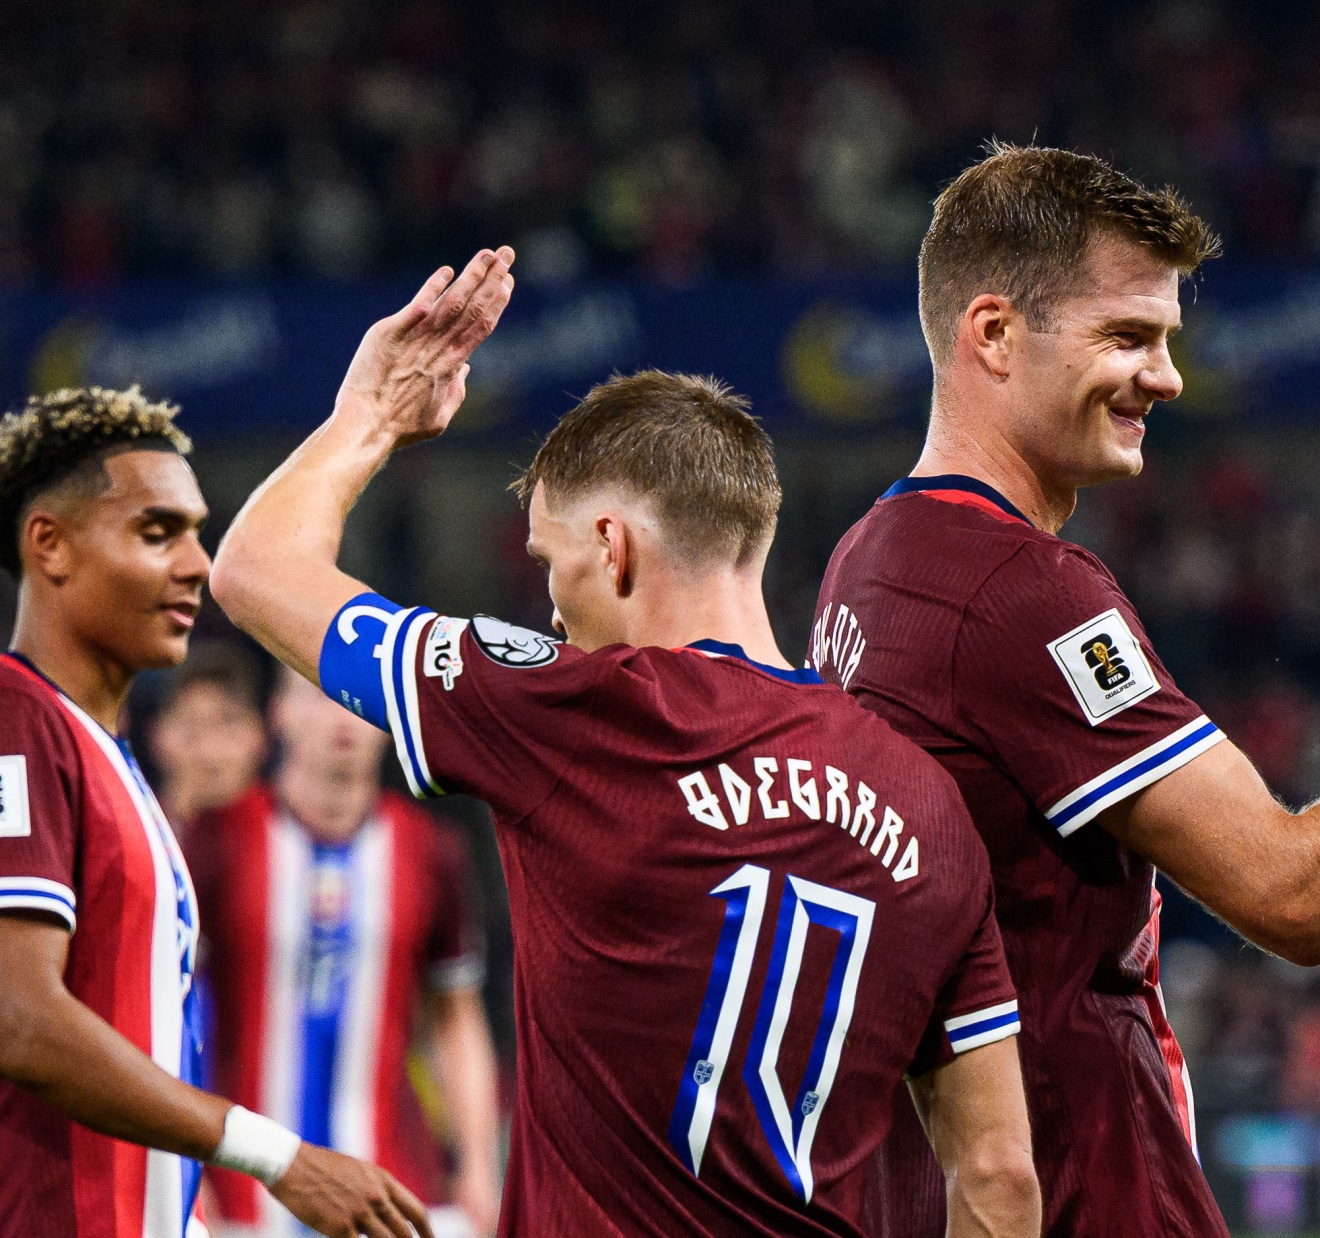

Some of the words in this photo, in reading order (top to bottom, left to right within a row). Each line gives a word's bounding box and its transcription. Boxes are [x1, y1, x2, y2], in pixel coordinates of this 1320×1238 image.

[804, 602, 867, 692] ØRLOTH
[1104, 680, 1136, 700] QUALIFIERS
[1107, 673, 1125, 685] FIFA
[667, 863, 877, 1208] 10
